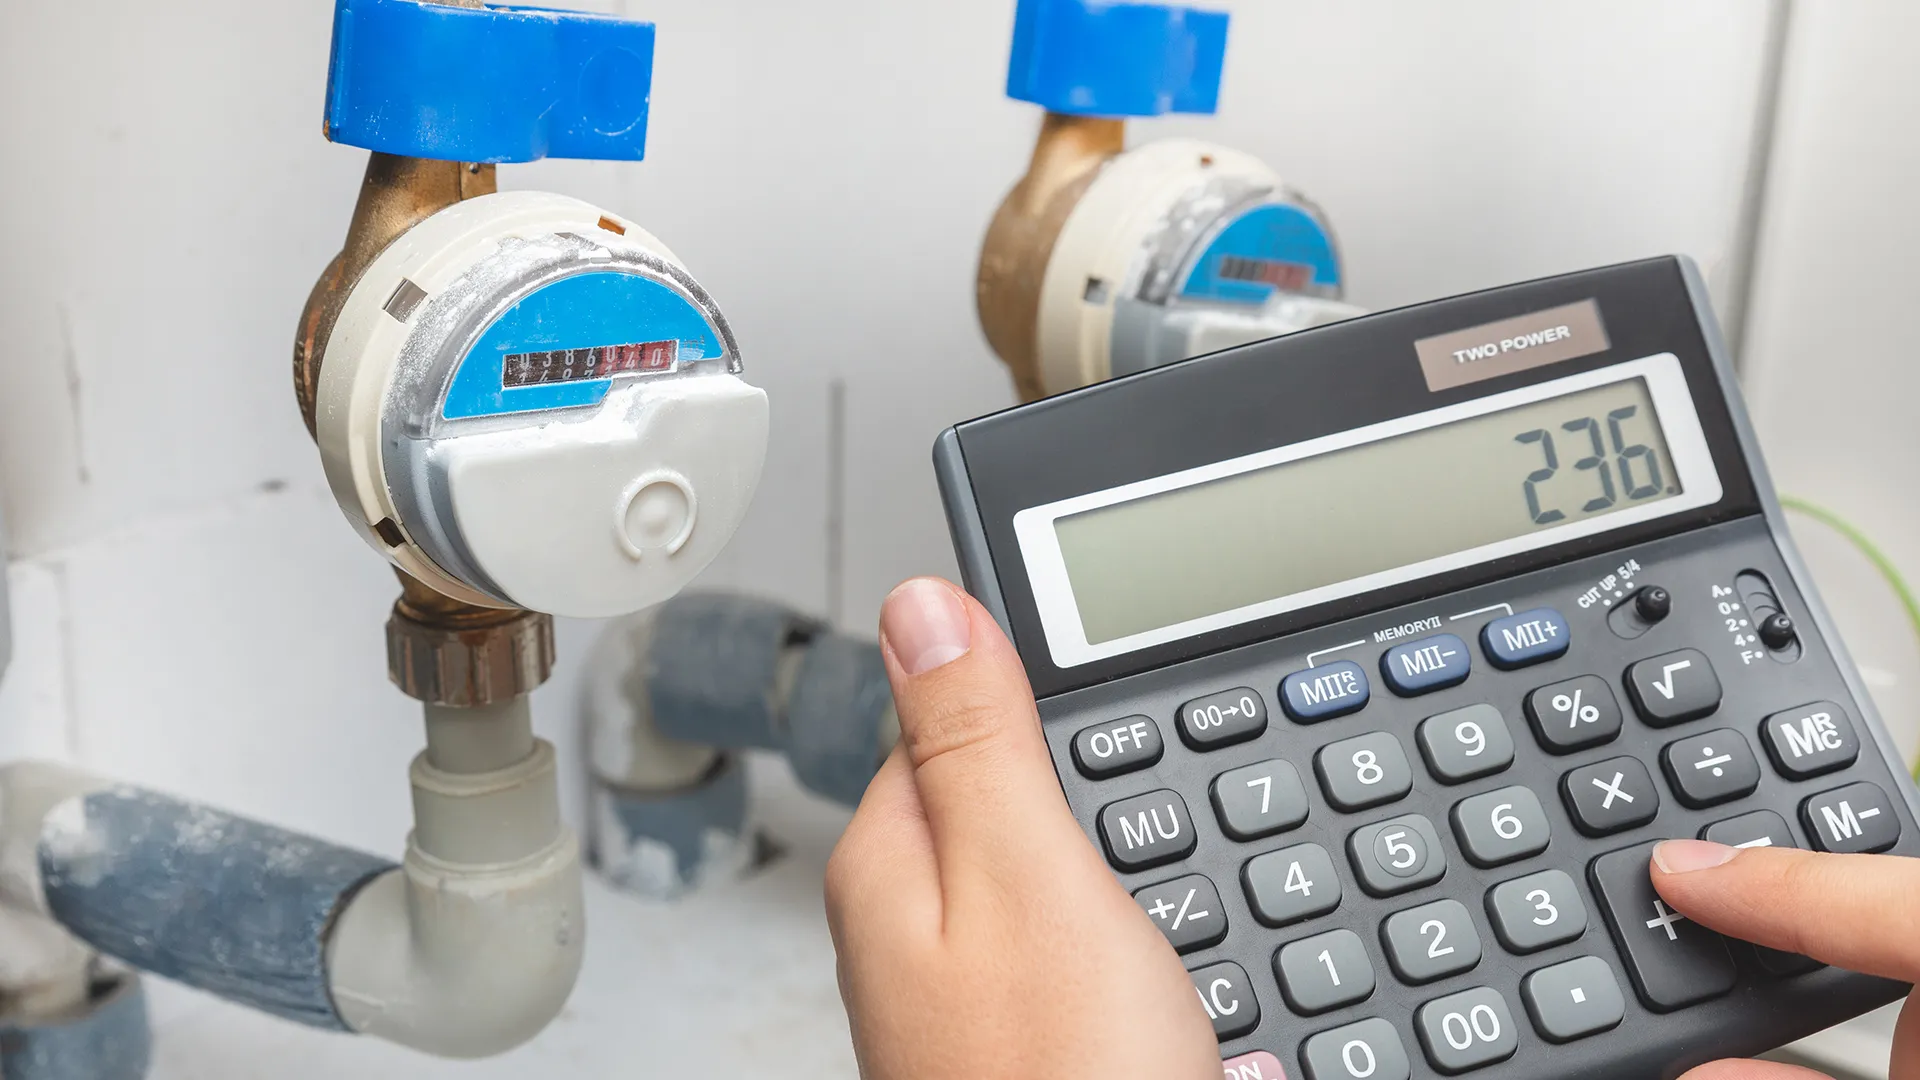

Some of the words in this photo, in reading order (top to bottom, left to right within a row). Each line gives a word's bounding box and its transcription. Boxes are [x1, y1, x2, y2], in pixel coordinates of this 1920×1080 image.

[1452, 343, 1498, 364] TWO
[1500, 325, 1571, 353] POWER
[1577, 588, 1603, 609] CUT
[1599, 574, 1618, 592] UP
[1617, 559, 1642, 580] 5/4
[1711, 584, 1726, 598] A
[1725, 619, 1740, 632] 2
[1734, 634, 1747, 648] 4
[1740, 651, 1756, 665] F
[1089, 721, 1149, 759] OFF
[1454, 721, 1486, 757] 9
[1351, 749, 1385, 785] 8
[1246, 774, 1274, 815] 7
[1118, 803, 1181, 850] MU
[1490, 803, 1524, 840] 6
[1384, 831, 1417, 869] 5
[1283, 860, 1315, 897] 4
[1524, 888, 1559, 926] 3
[1419, 919, 1455, 959] 2
[1317, 949, 1341, 987] 1
[1441, 1003, 1501, 1051] 00
[1341, 1039, 1377, 1079] 0
